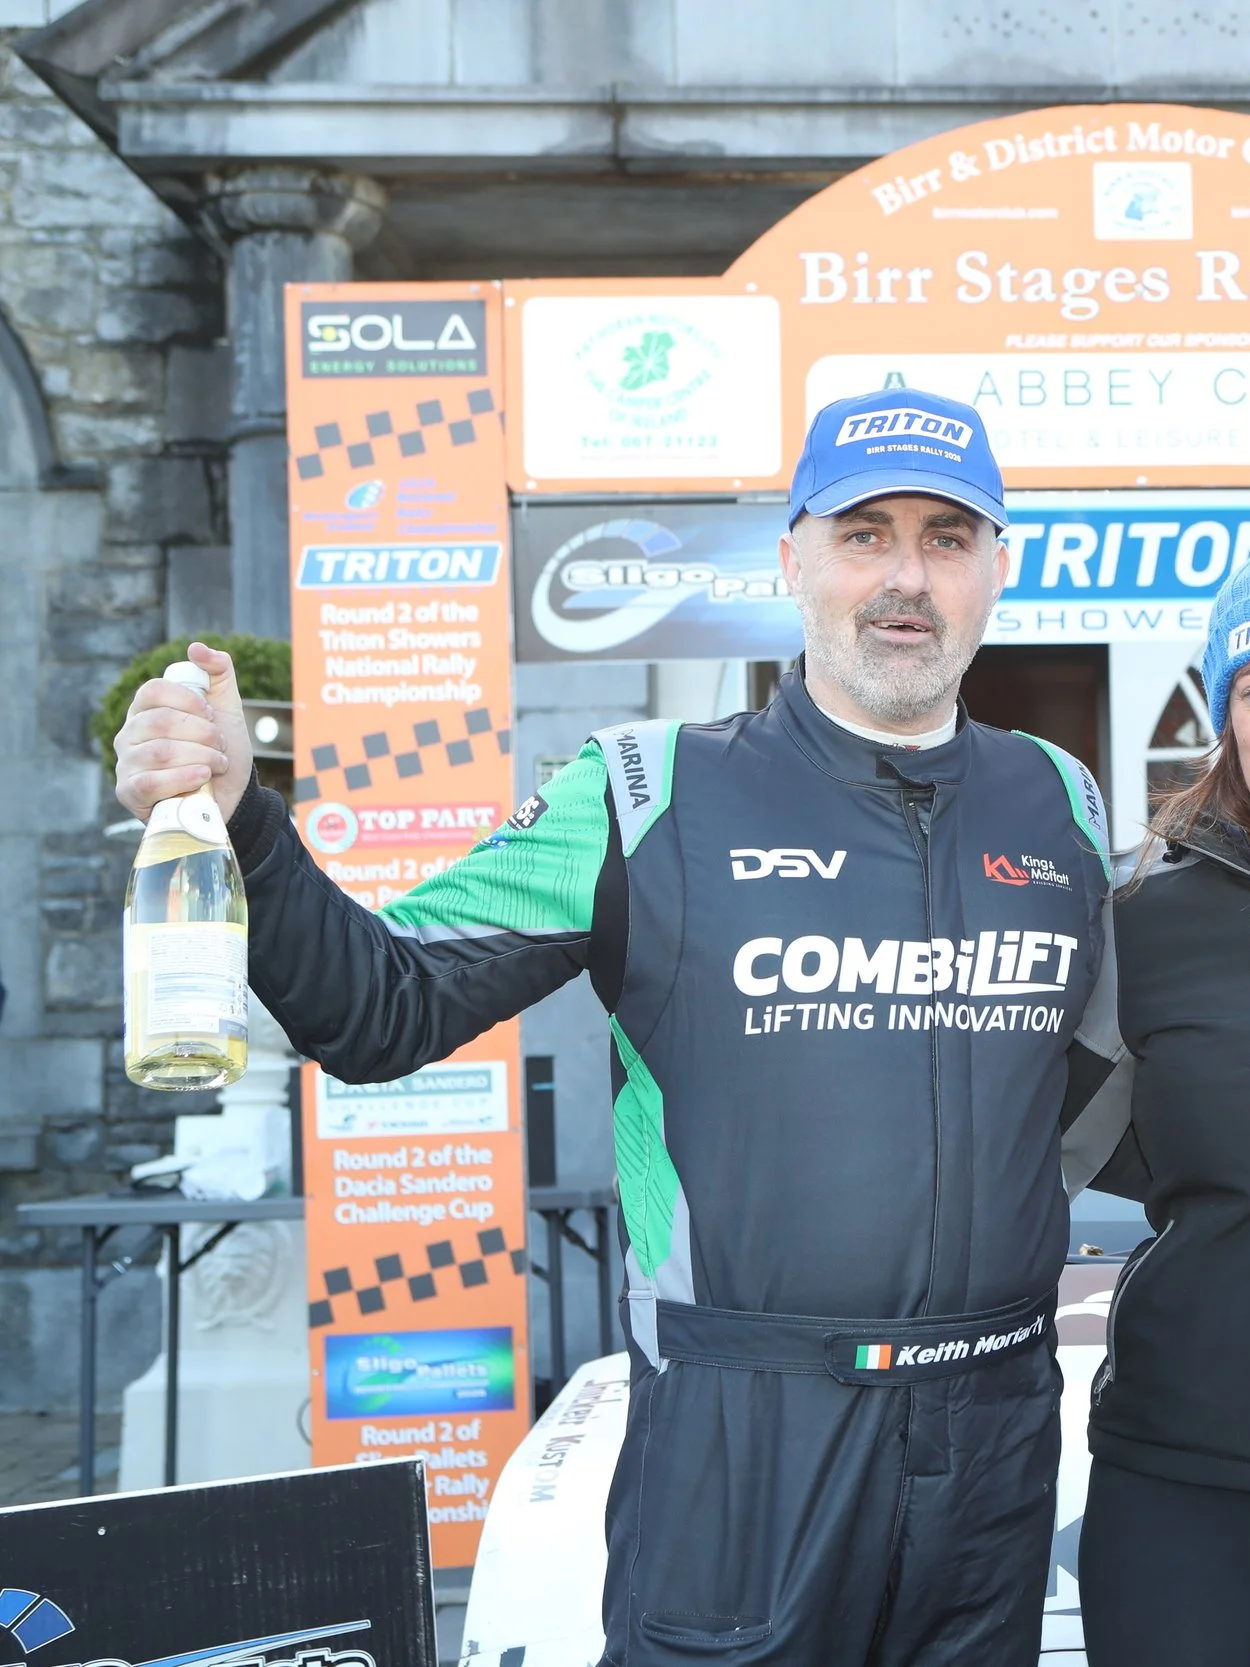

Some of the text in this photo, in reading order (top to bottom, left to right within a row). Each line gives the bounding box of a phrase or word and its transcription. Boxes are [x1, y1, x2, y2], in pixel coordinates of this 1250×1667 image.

[871, 163, 944, 218] Birr
[947, 149, 982, 183] &
[982, 125, 1119, 173] District
[1127, 121, 1234, 160] Motor
[800, 251, 932, 305] Birr
[954, 249, 1171, 322] Stages
[308, 314, 477, 352] SOLA
[309, 358, 478, 374] ENERGY SOLUTIONS
[973, 368, 1172, 406] ABBEY
[848, 412, 965, 441] TRITON
[992, 429, 1067, 450] OTEL
[1117, 428, 1241, 448] LEISURE
[866, 446, 886, 455] BIRR
[887, 443, 919, 453] STAGES
[920, 446, 943, 457] RALLY
[315, 549, 484, 583] TRITON
[565, 562, 794, 600] Sligo Pal
[321, 600, 479, 625] Round 2 of the
[996, 609, 1204, 631] SHOWE
[318, 627, 482, 651] Triton Showers
[325, 652, 477, 680] National Rally
[320, 679, 482, 708] Championship
[613, 728, 651, 810] MARINA
[1075, 760, 1101, 831] MARIN
[358, 809, 415, 830] TOP
[420, 807, 495, 829] PART
[325, 858, 400, 881] Round
[403, 858, 418, 880] 2
[729, 848, 848, 881] DSV
[1021, 854, 1055, 871] King &
[1030, 867, 1070, 886] Moffatt
[888, 1001, 1064, 1034] INNOVATION
[411, 1073, 489, 1092] SANDERO
[333, 1143, 493, 1171] Round 2 of the
[334, 1171, 493, 1198] Dacia Sandero
[334, 1198, 495, 1226] Challenge Cup
[356, 1356, 488, 1378] Sligo Pallets
[896, 1340, 970, 1366] Keith
[360, 1418, 482, 1447] Round 2 of
[433, 1472, 489, 1498] Rally
